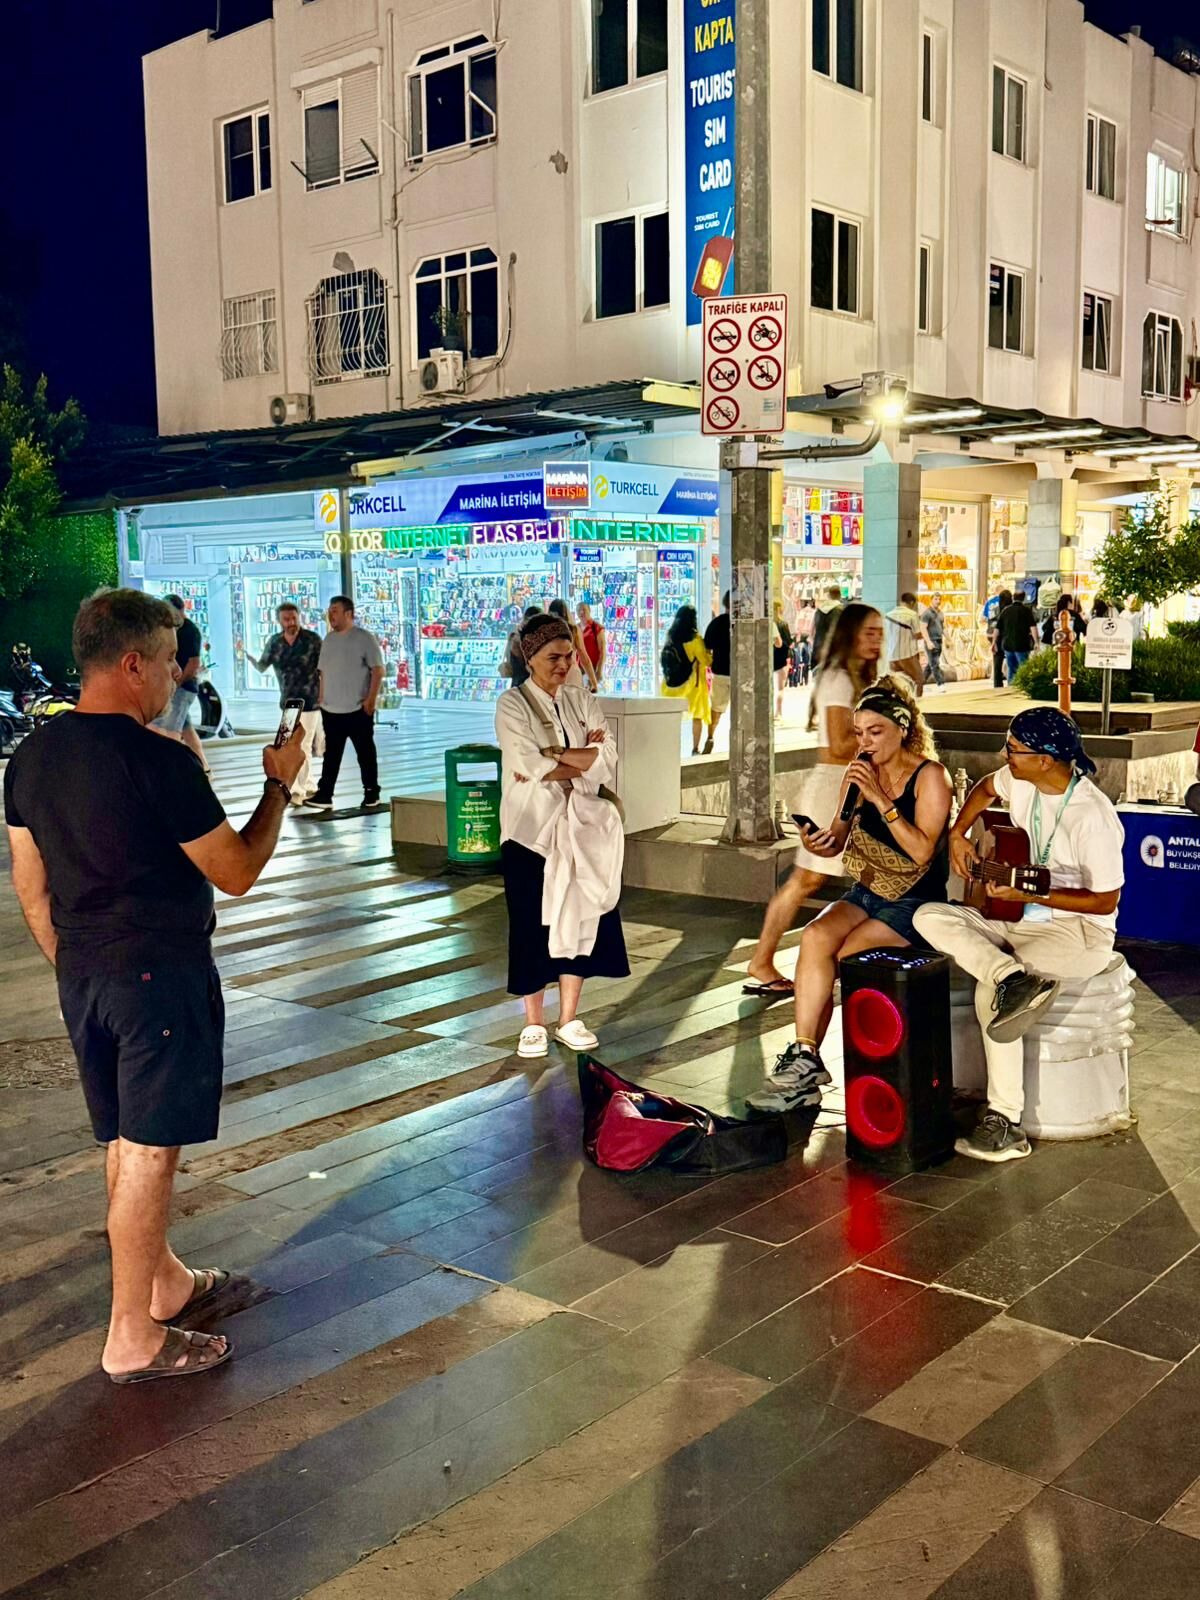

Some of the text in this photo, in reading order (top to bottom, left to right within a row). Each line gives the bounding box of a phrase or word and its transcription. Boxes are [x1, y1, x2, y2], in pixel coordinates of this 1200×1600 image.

[704, 115, 727, 148] SIM
[699, 158, 732, 192] CARD
[695, 211, 719, 223] TOURIST
[694, 219, 721, 231] SIM CARD
[707, 300, 784, 315] TRAFİĞE KAPALI
[546, 470, 588, 484] MARİNA
[546, 485, 587, 500] İLETİŞİM
[610, 481, 659, 496] TURKCELL
[459, 490, 541, 510] MARİNA İLETİŞİM
[570, 519, 705, 542] INTERNET
[1167, 836, 1200, 847] ANTAL
